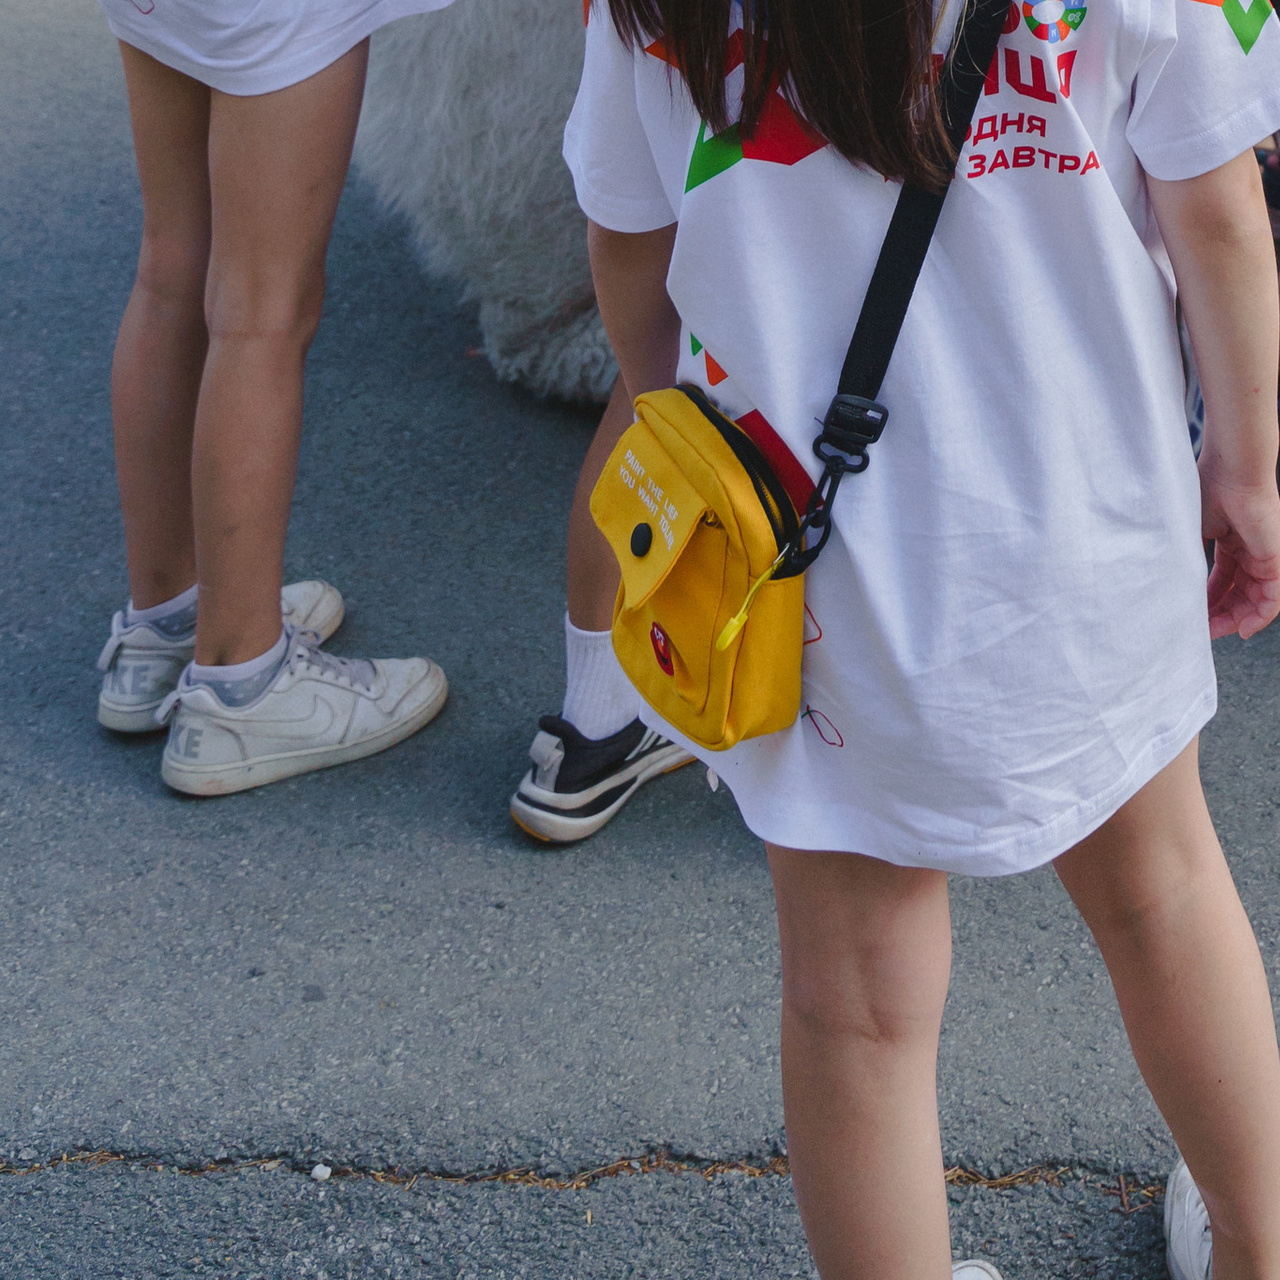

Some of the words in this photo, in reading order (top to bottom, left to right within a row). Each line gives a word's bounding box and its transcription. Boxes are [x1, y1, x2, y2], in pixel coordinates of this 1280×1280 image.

[619, 464, 635, 489] YOU
[638, 484, 659, 518] WANT
[625, 449, 646, 479] PAINT
[648, 477, 664, 501] THE
